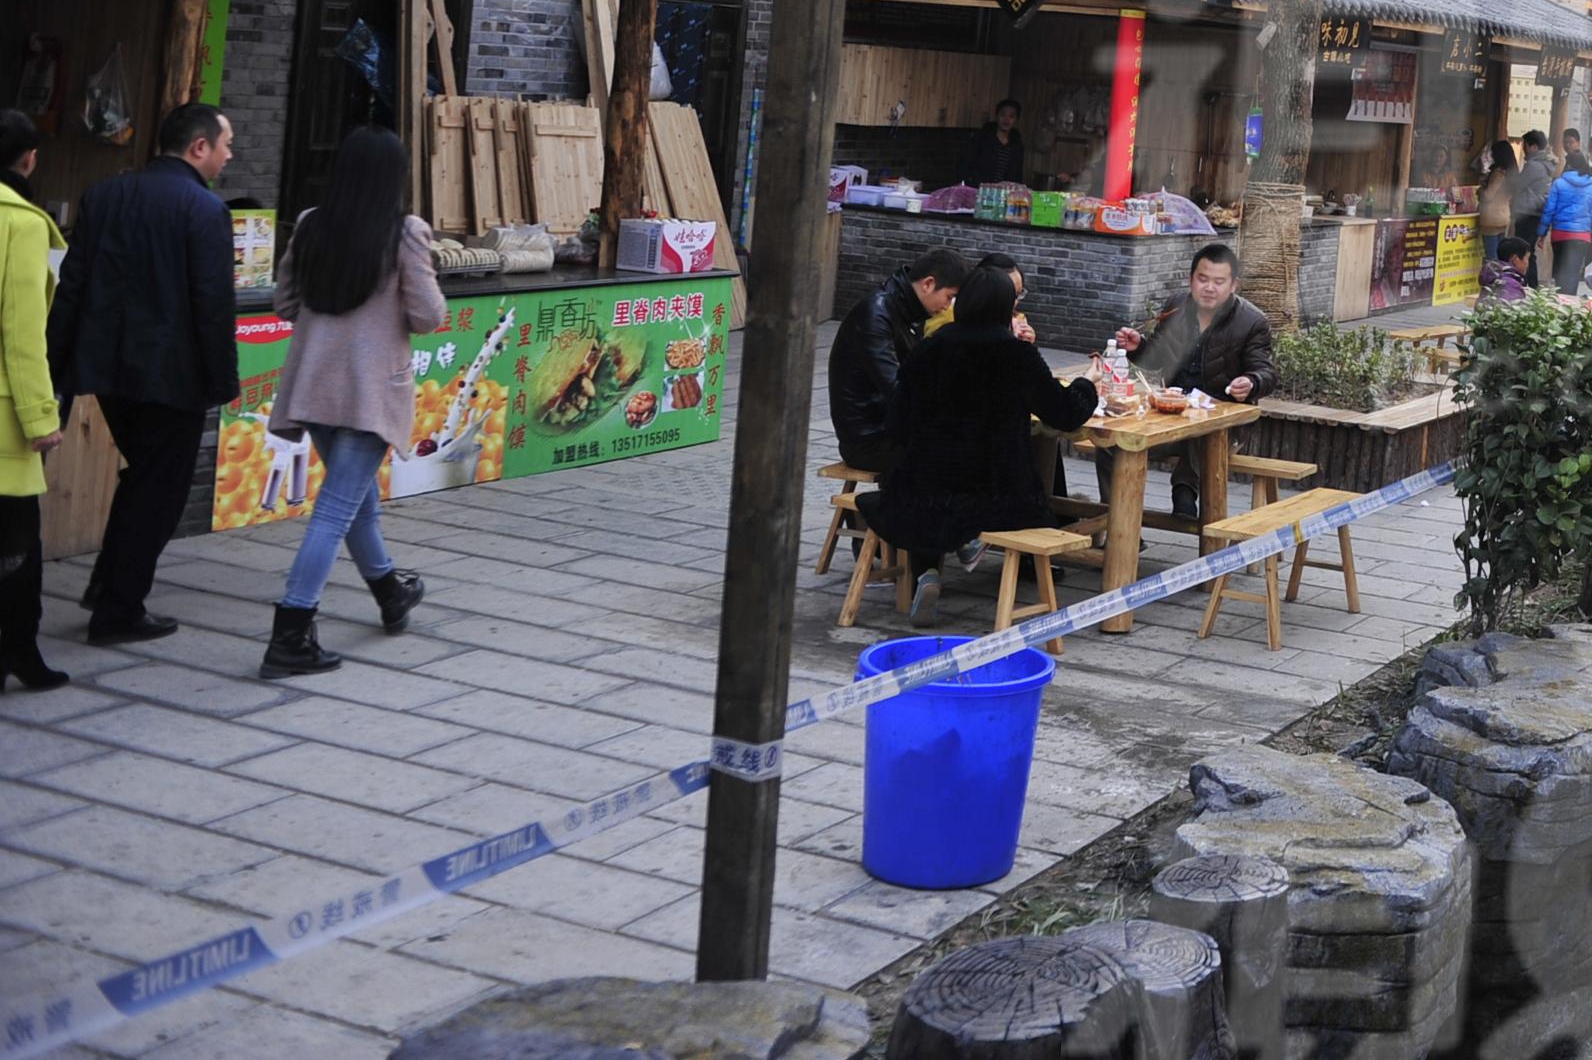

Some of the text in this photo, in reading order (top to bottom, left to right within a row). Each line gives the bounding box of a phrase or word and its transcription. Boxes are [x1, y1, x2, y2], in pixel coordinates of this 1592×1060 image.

[611, 292, 705, 327] 里脊肉夹馍
[704, 302, 726, 417] 香飘万里
[508, 322, 532, 450] 里脊肉馍
